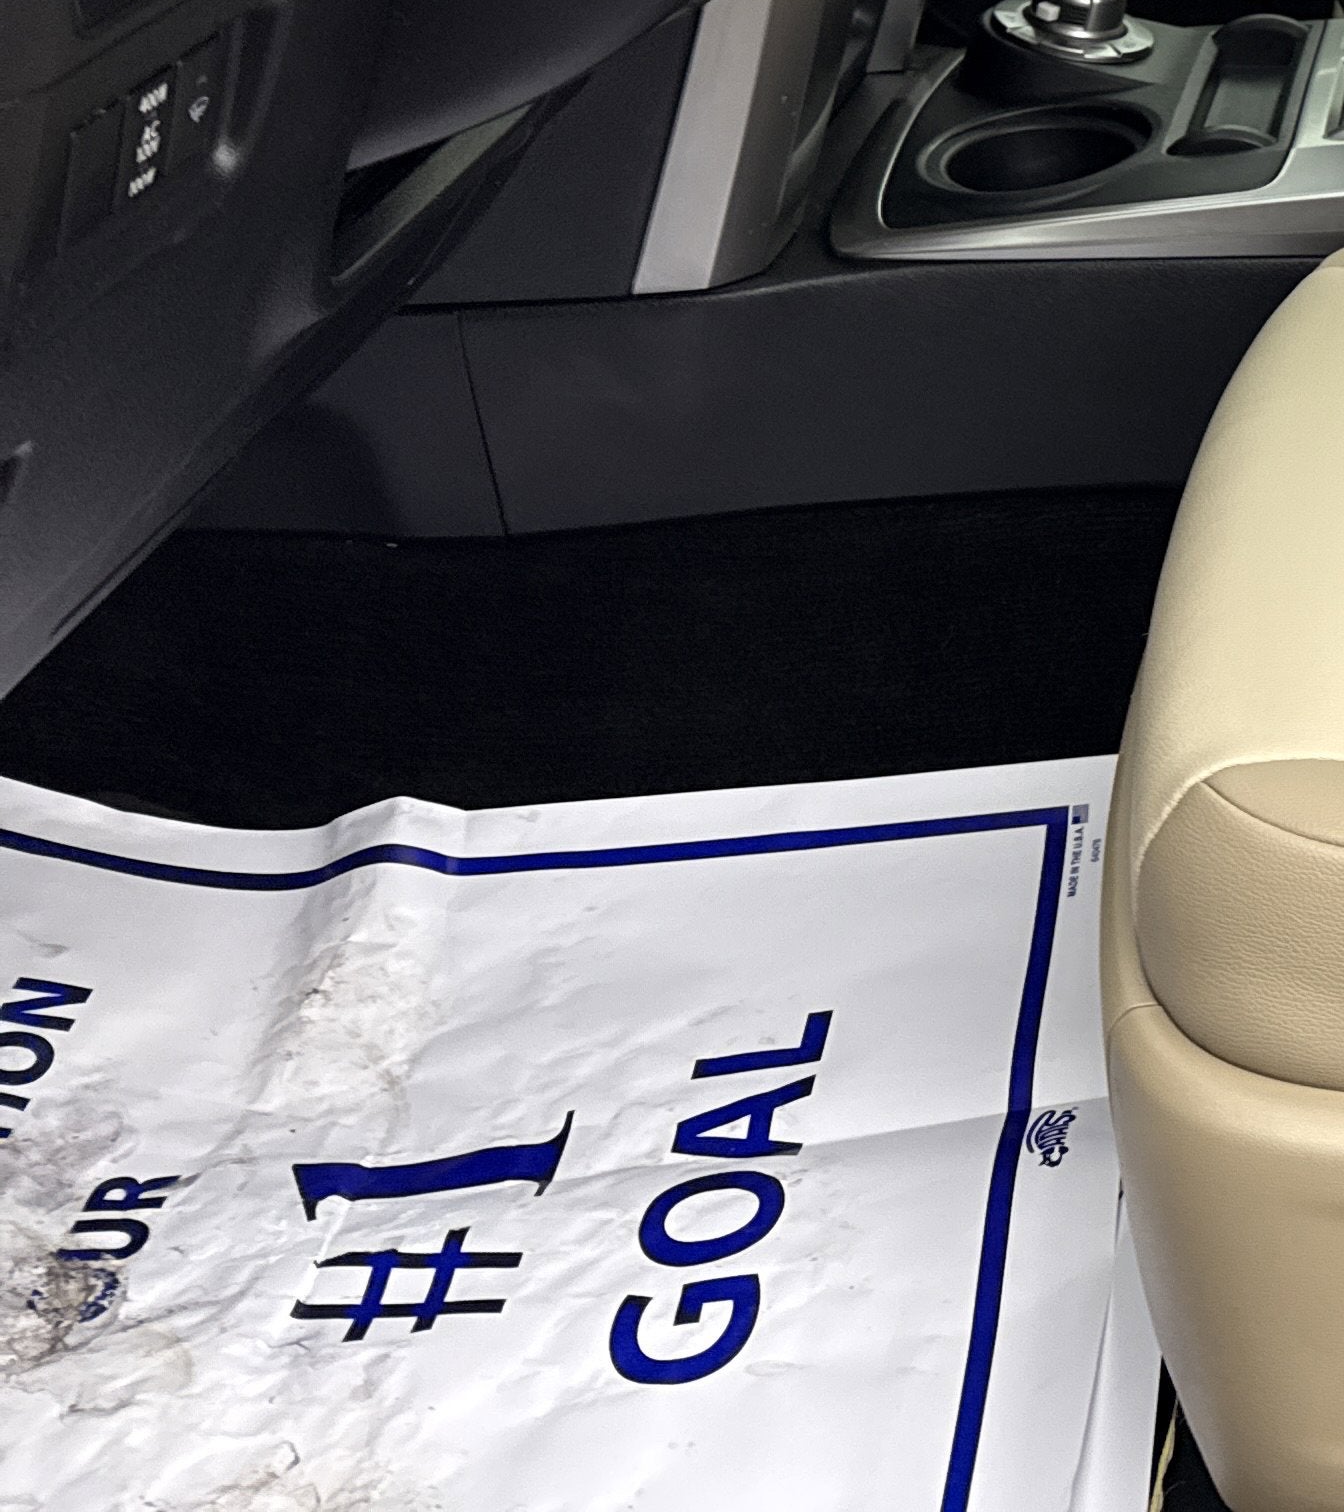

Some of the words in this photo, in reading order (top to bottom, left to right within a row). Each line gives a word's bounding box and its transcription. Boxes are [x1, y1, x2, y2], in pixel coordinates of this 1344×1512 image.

[1071, 850, 1082, 865] THE
[291, 1110, 574, 1342] #1
[609, 1010, 833, 1384] GOAL
